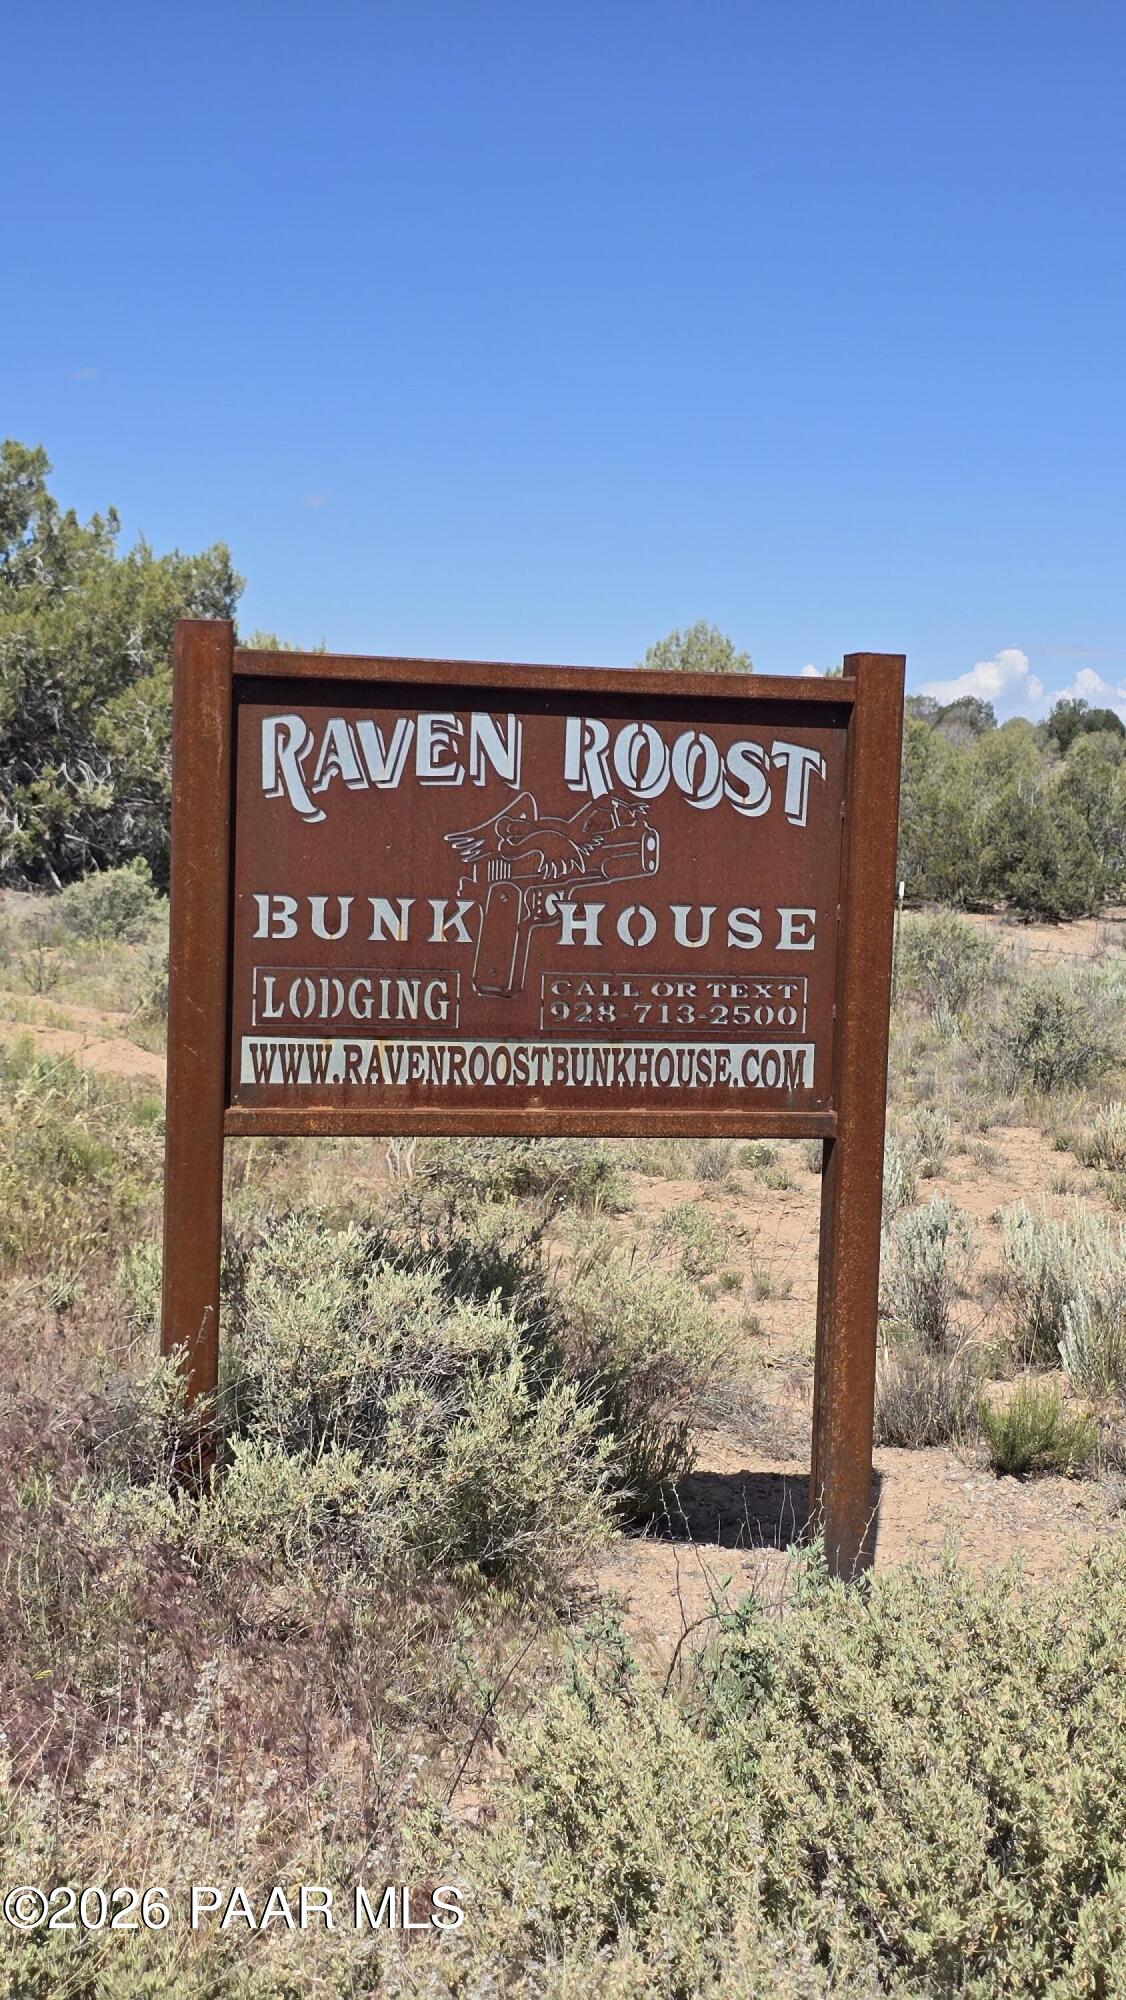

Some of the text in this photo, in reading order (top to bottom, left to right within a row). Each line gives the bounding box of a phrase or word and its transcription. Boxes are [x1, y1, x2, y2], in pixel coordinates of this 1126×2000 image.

[261, 712, 826, 827] RAVEN ROOST
[253, 894, 817, 951] BUNK HOUSE
[262, 976, 449, 1020] LODGING
[552, 980, 799, 999] CALL OR TEXT
[551, 1002, 799, 1026] 928-713-2500
[249, 1043, 807, 1088] WWW.RAVENROOSTBUNKHOUSE.COM
